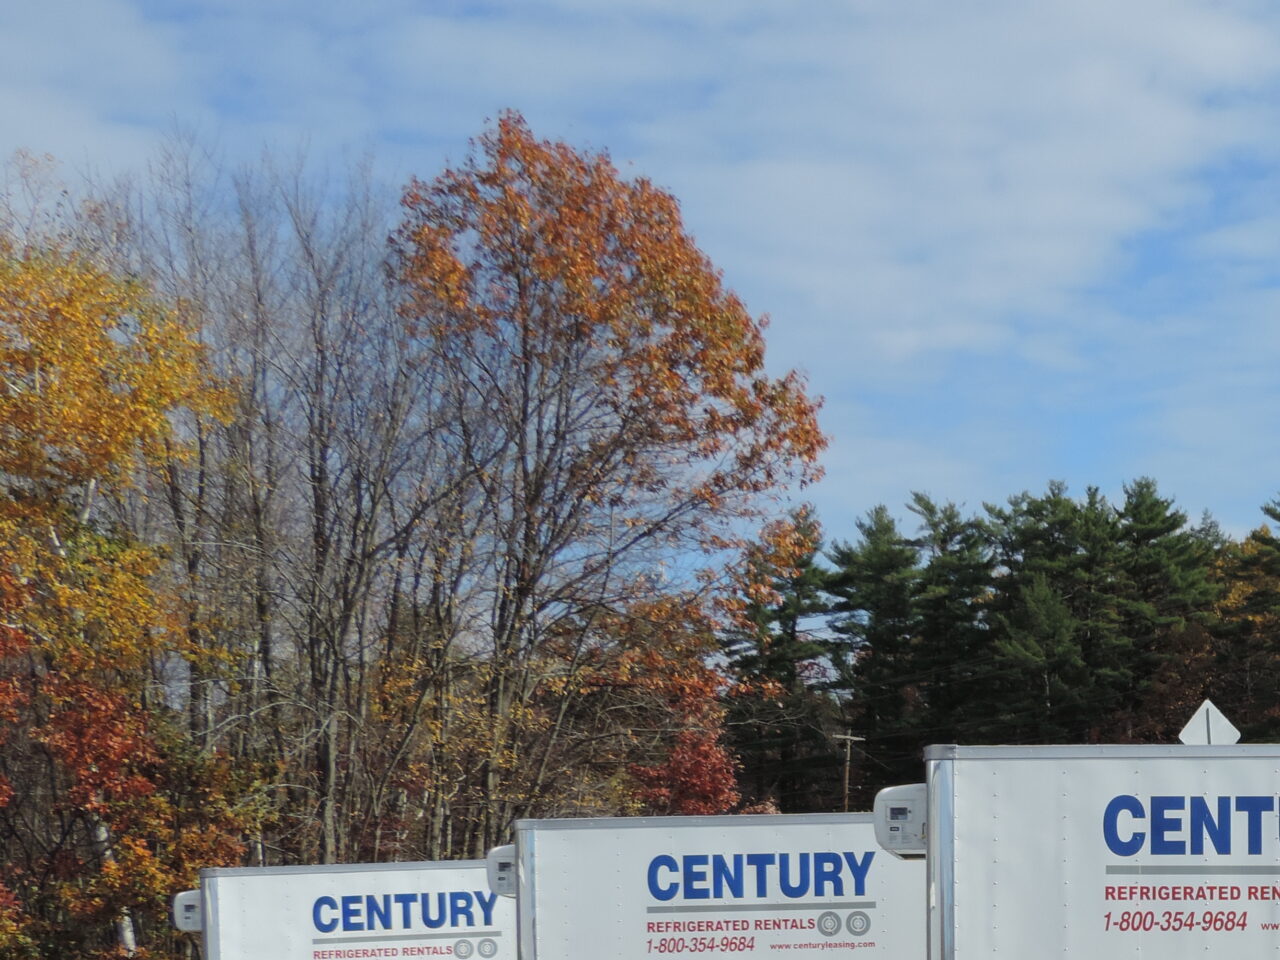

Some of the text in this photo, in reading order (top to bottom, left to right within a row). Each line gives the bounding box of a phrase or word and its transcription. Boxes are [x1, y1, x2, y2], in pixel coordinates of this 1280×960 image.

[647, 851, 876, 902] CENTURY
[1104, 886, 1241, 901] REFRIGERATED
[312, 891, 497, 933] CENTURY
[646, 917, 815, 933] REFRIGERATED RENTALS
[1103, 910, 1248, 932] 1-800-354-9684
[312, 946, 453, 960] REFRIGERATED RENTALS
[646, 936, 755, 954] 1-800-354-9684
[769, 940, 876, 951] wwwcenturyleasing.com
